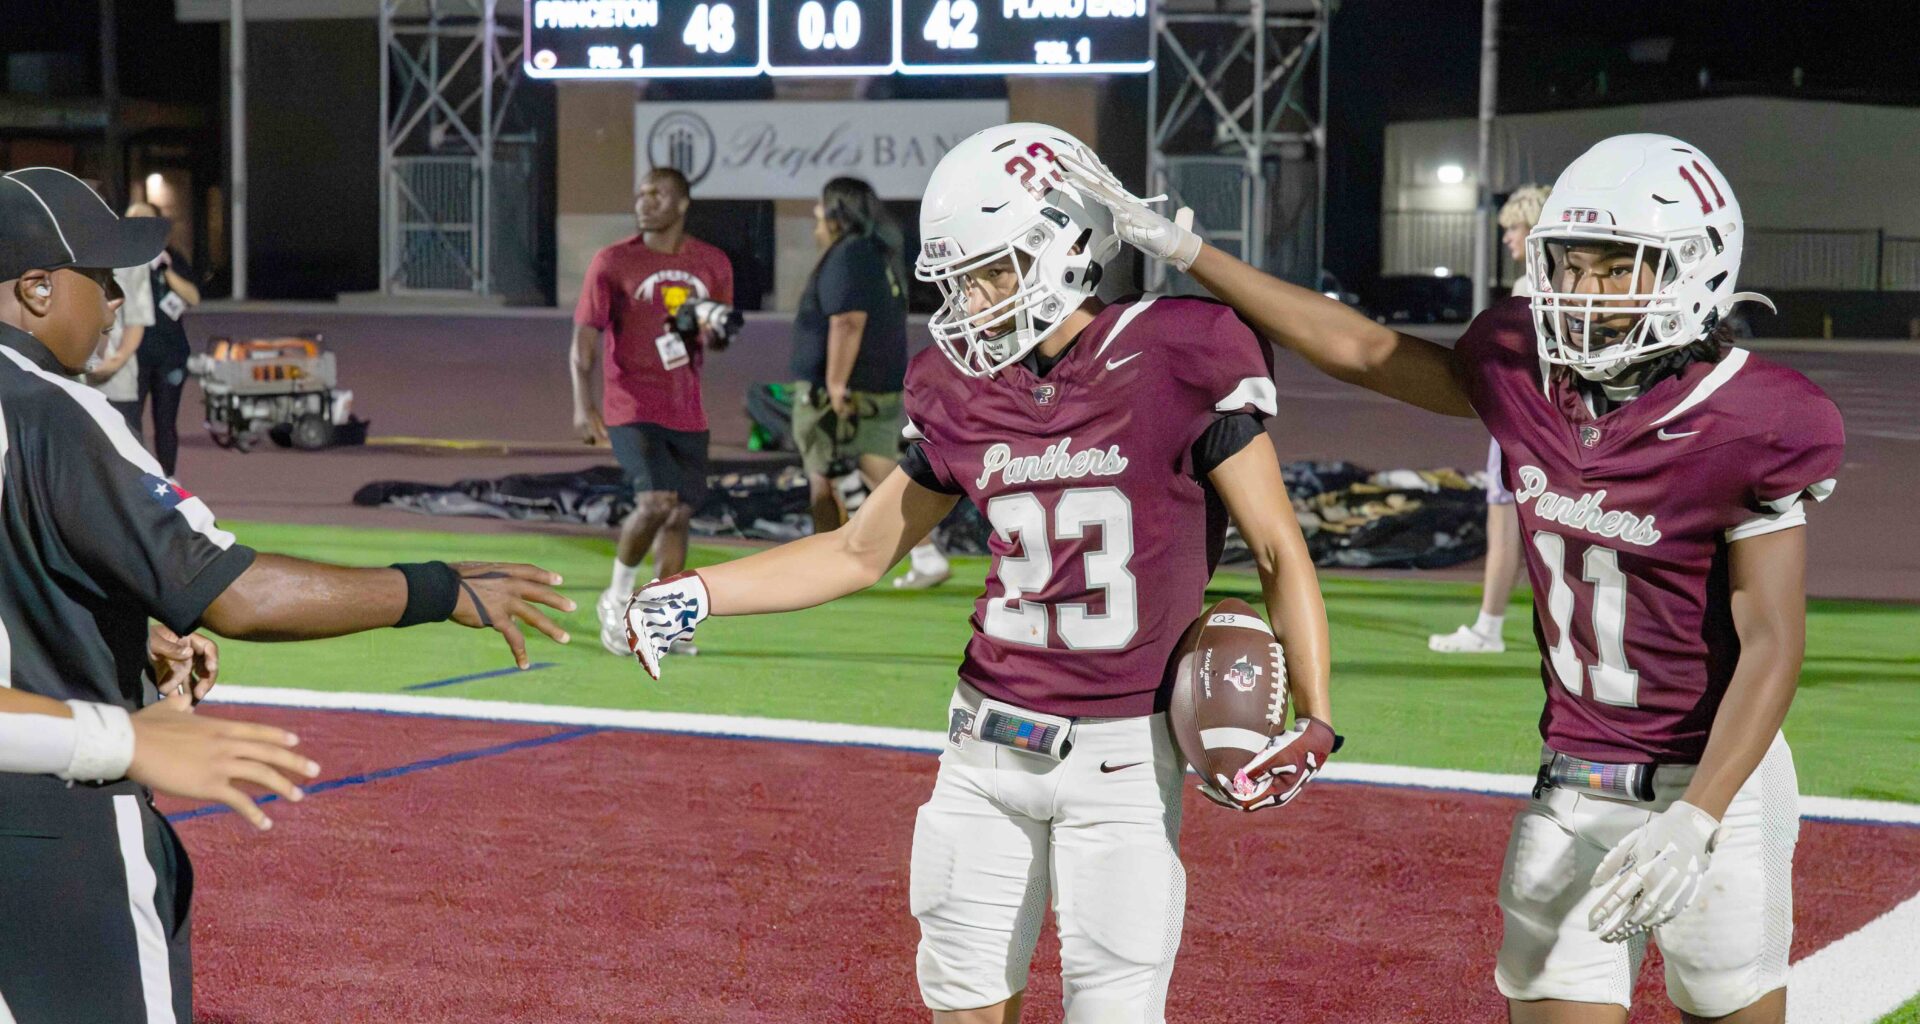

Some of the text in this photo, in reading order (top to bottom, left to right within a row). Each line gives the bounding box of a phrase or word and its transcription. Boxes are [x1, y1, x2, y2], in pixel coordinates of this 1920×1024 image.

[683, 4, 735, 53] 48
[798, 1, 861, 49] 0.0
[923, 0, 978, 49] 42
[629, 44, 643, 68] 1
[1076, 37, 1091, 64] 1
[873, 134, 962, 167] BAN
[1005, 142, 1064, 201] 23
[1679, 160, 1726, 215] 11
[976, 437, 1128, 490] Panthers
[1516, 465, 1662, 546] Panthers
[984, 486, 1138, 650] 23
[1212, 614, 1235, 624] Q3
[1533, 529, 1639, 708] 11
[1204, 647, 1213, 672] TEAM
